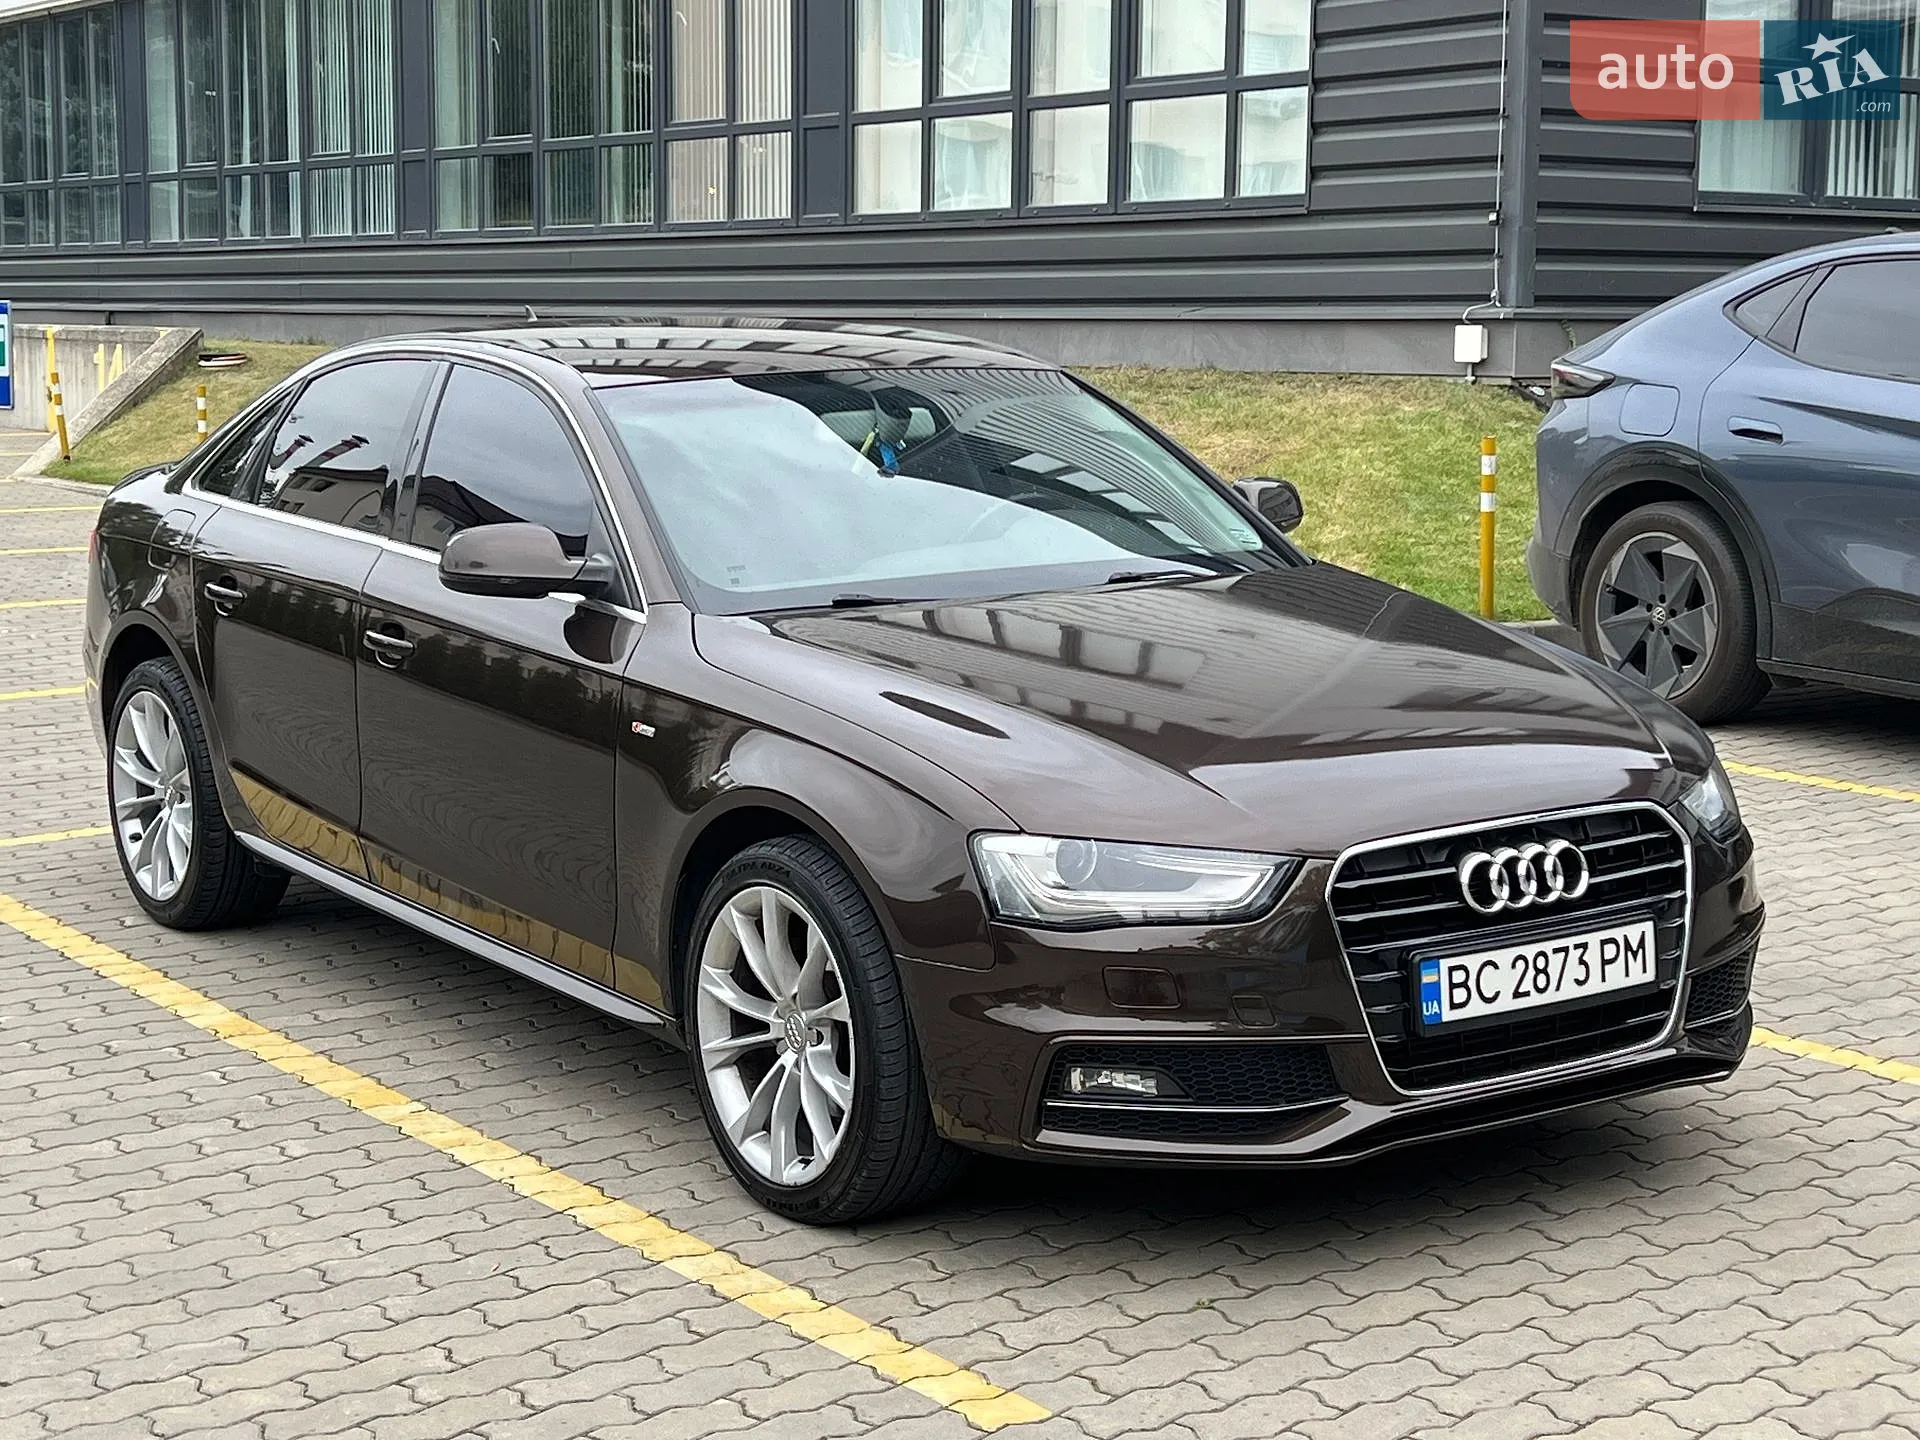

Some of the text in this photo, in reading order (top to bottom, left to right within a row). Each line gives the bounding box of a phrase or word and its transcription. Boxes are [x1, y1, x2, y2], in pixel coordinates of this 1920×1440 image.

[1448, 930, 1647, 1010] BC 2873 PM
[1423, 1002, 1440, 1015] UA
